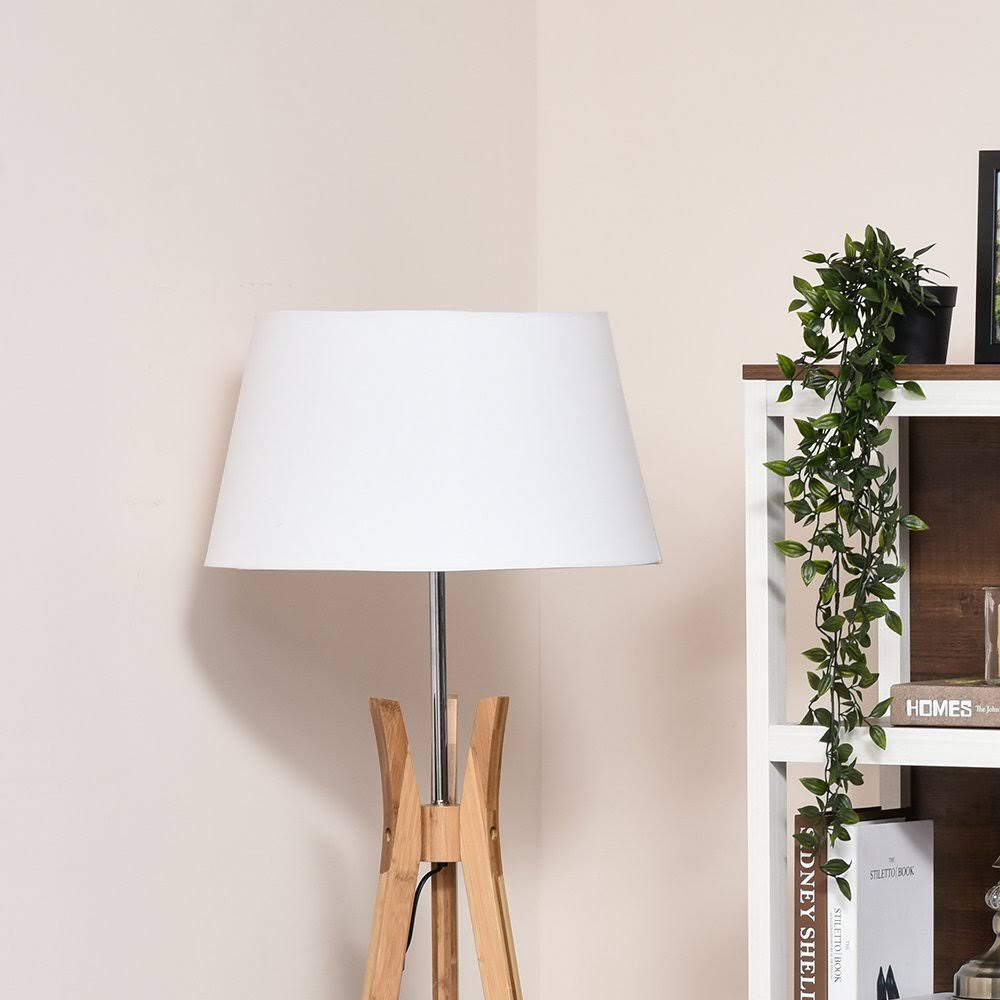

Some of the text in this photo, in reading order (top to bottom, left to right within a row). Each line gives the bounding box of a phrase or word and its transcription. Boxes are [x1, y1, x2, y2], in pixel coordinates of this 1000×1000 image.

[906, 699, 972, 717] HOMES
[975, 704, 986, 713] The
[986, 704, 1000, 714] John
[800, 827, 816, 921] DNEY
